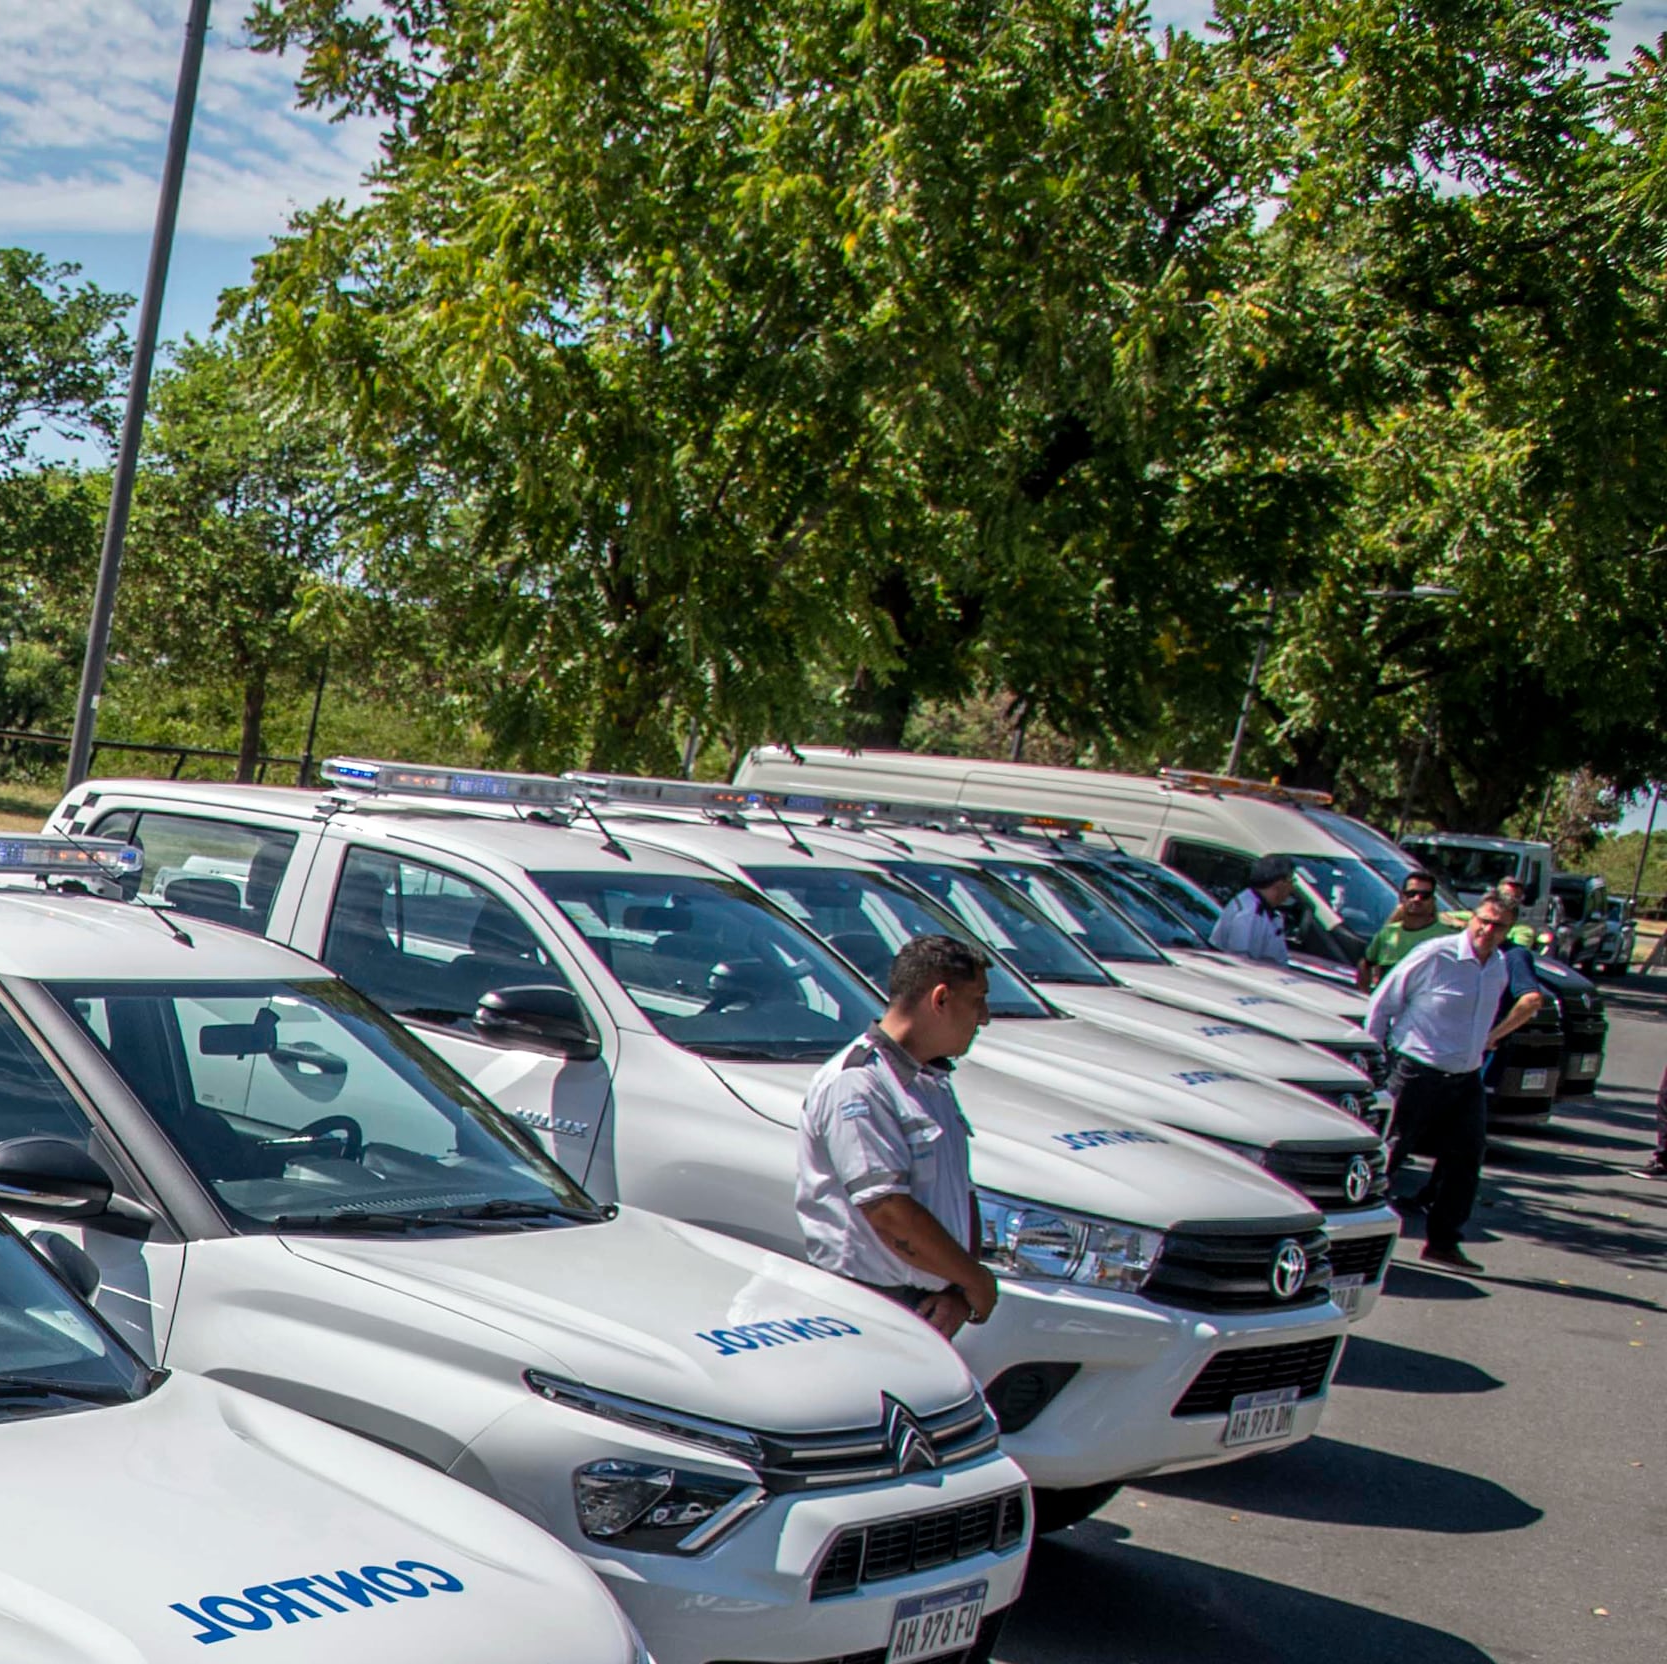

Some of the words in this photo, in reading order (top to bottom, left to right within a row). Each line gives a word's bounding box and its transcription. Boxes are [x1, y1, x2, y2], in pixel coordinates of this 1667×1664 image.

[892, 1618, 920, 1658] AH
[919, 1610, 954, 1651] 978
[953, 1602, 979, 1642] FU
